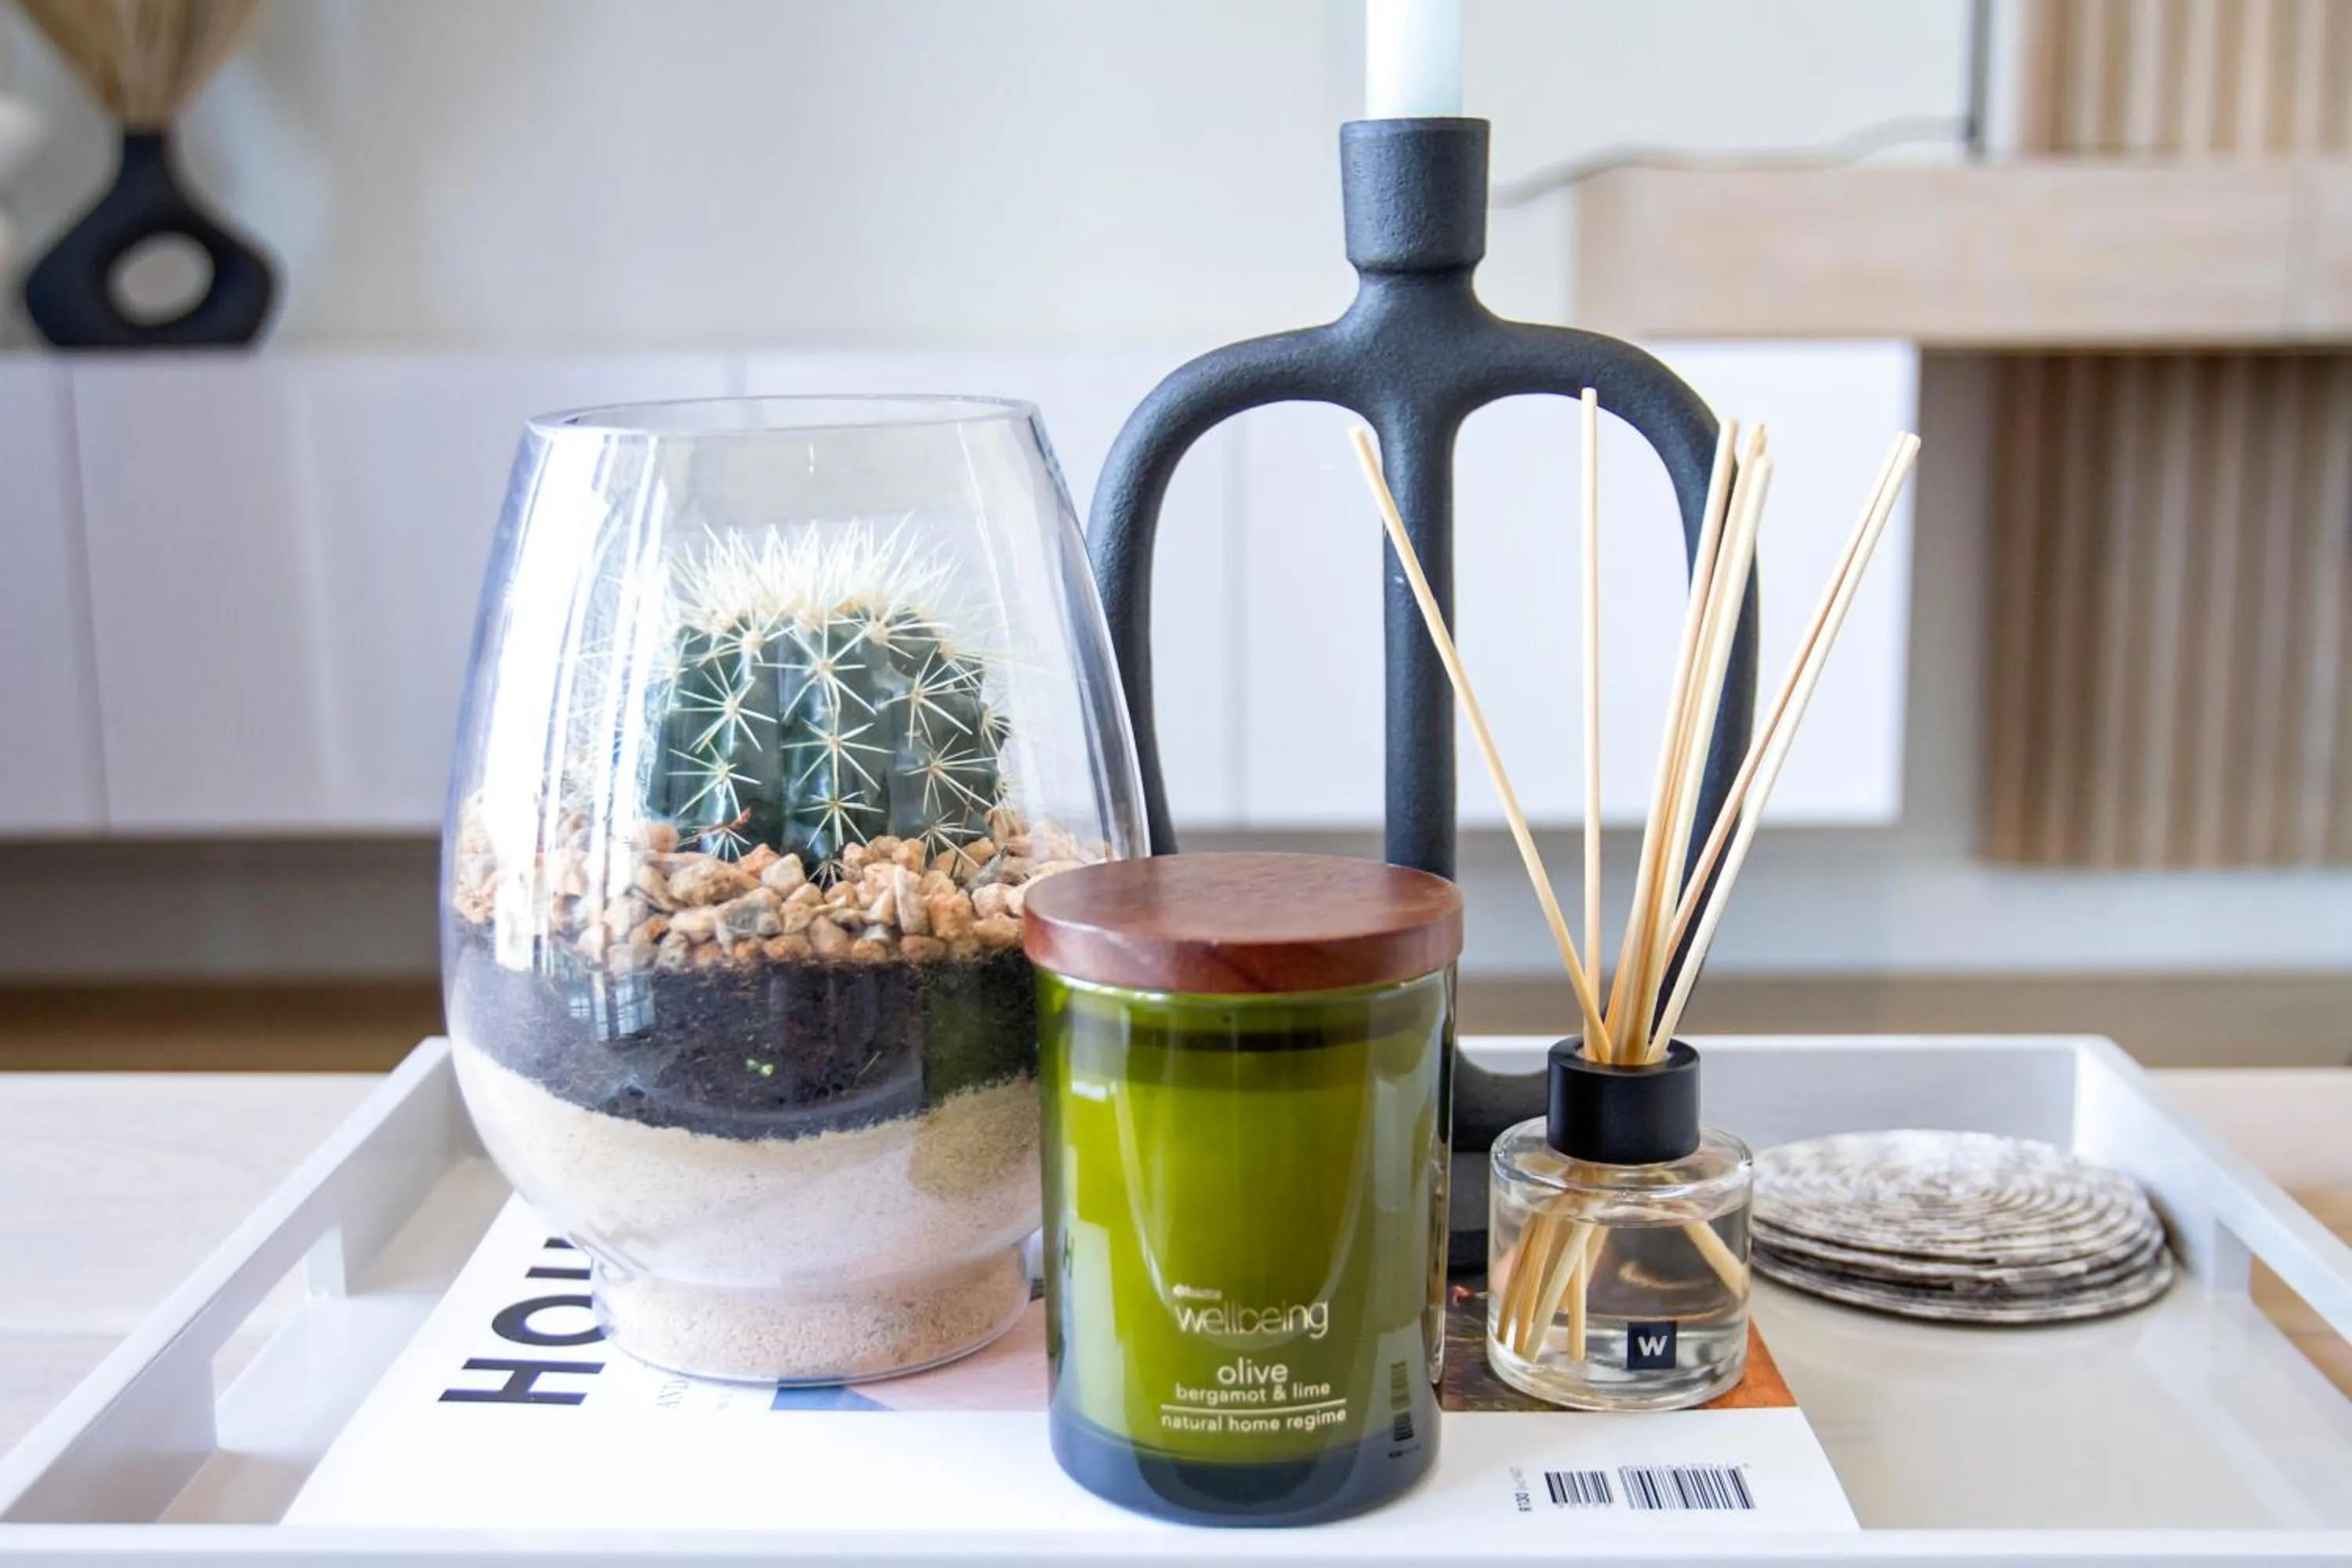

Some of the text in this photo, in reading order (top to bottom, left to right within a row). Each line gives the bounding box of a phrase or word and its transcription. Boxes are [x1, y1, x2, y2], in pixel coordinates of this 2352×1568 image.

[1175, 1300, 1329, 1338] wellbeing
[1217, 1356, 1288, 1385] olive
[1176, 1381, 1330, 1405] bergamot & lime
[1161, 1407, 1347, 1432] natural home regime
